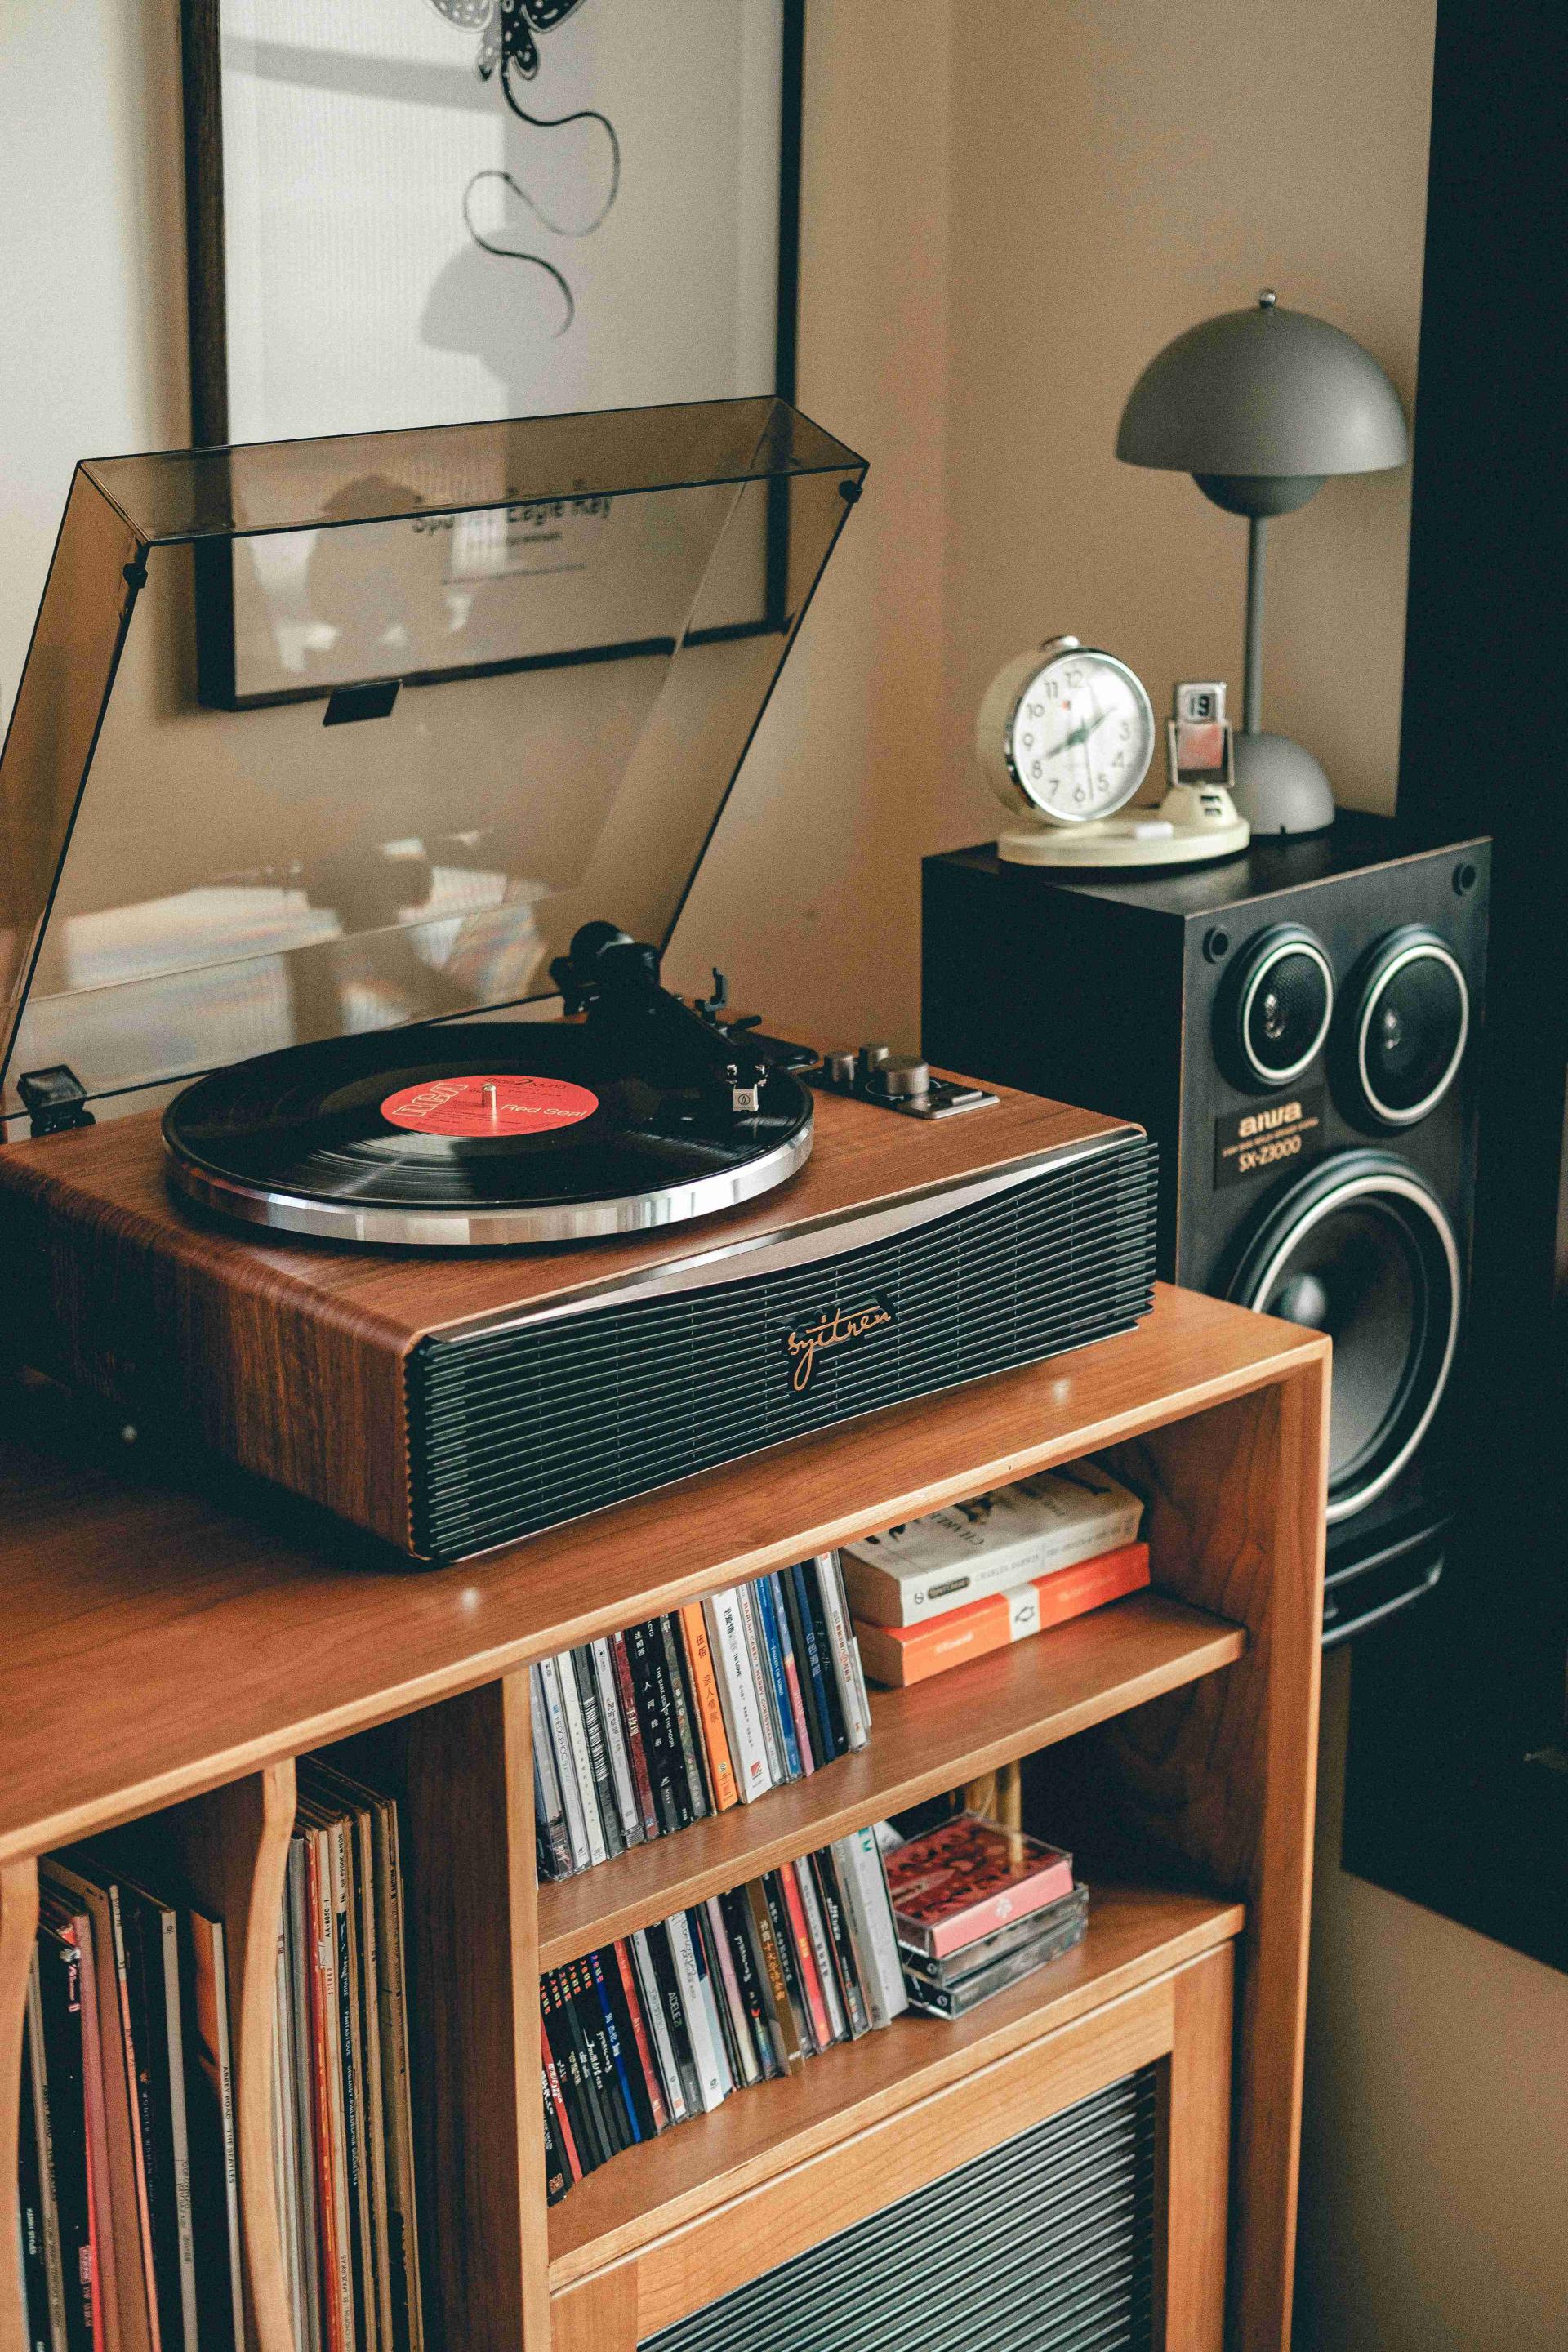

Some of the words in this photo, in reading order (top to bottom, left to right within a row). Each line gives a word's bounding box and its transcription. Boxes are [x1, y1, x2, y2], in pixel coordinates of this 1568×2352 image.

[1045, 679, 1059, 698] 11
[1065, 670, 1084, 688] 12
[1027, 702, 1045, 718] 10
[1022, 733, 1034, 751] 9
[1032, 760, 1044, 779] 8
[1049, 779, 1061, 796] 7
[1097, 775, 1110, 792] 5
[1074, 786, 1086, 803] 6
[500, 1103, 542, 1113] Red
[543, 1107, 587, 1117] Seal
[1239, 1101, 1303, 1138] aiwa
[743, 1601, 752, 1633] MARIAH
[749, 1634, 758, 1663] CAREY
[755, 1668, 764, 1698] MERRY
[760, 1699, 773, 1742] CHRISTMAS
[668, 1991, 681, 2019] ADELE
[224, 2096, 232, 2120] ROAD
[227, 2147, 237, 2184] BEATLES
[341, 2254, 349, 2294] MAZURKAS
